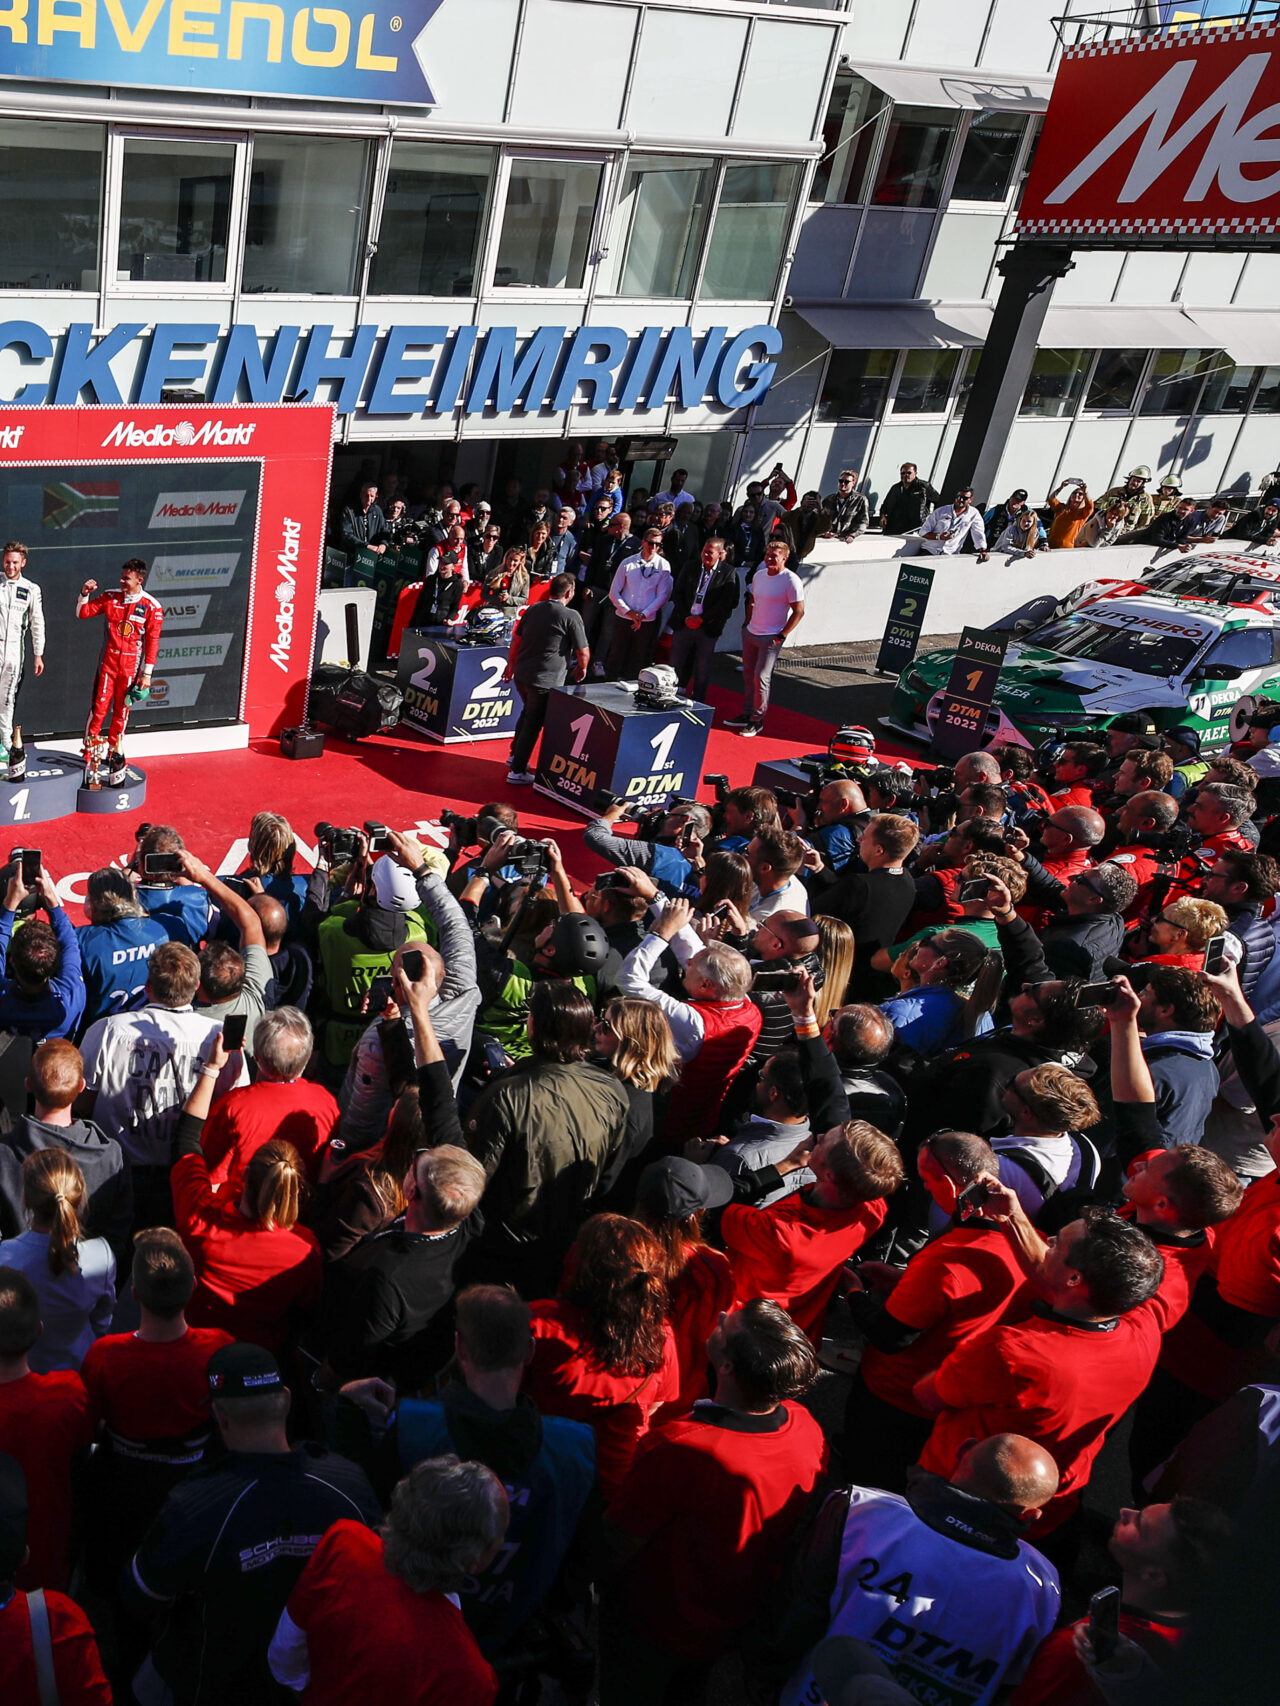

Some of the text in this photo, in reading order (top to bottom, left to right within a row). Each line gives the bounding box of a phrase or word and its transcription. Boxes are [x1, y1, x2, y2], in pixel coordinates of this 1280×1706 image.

[1200, 554, 1269, 569] SONAX
[175, 567, 230, 577] MICHELIN
[909, 574, 929, 586] DEKRA
[899, 598, 918, 617] 2
[1084, 607, 1203, 638] AUTOHERO
[890, 626, 915, 638] DTM
[888, 636, 912, 648] 2022
[974, 641, 1001, 655] DEKRA
[156, 645, 222, 659] CHAEFFLER
[966, 670, 984, 691] 1
[404, 688, 439, 716] DTM
[1194, 695, 1206, 712] 11
[1211, 690, 1241, 705] DEKRA
[408, 706, 429, 722] 2022
[461, 699, 513, 720] DTM
[949, 702, 982, 719] DTM
[471, 718, 499, 728] 2022
[945, 714, 978, 731] 2022
[548, 754, 598, 791] DTM
[556, 777, 583, 795] 2022
[625, 771, 684, 798] DTM
[637, 792, 668, 807] 2022
[112, 943, 157, 965] DTM
[856, 1558, 913, 1605] 24
[872, 1617, 1000, 1687] DTM
